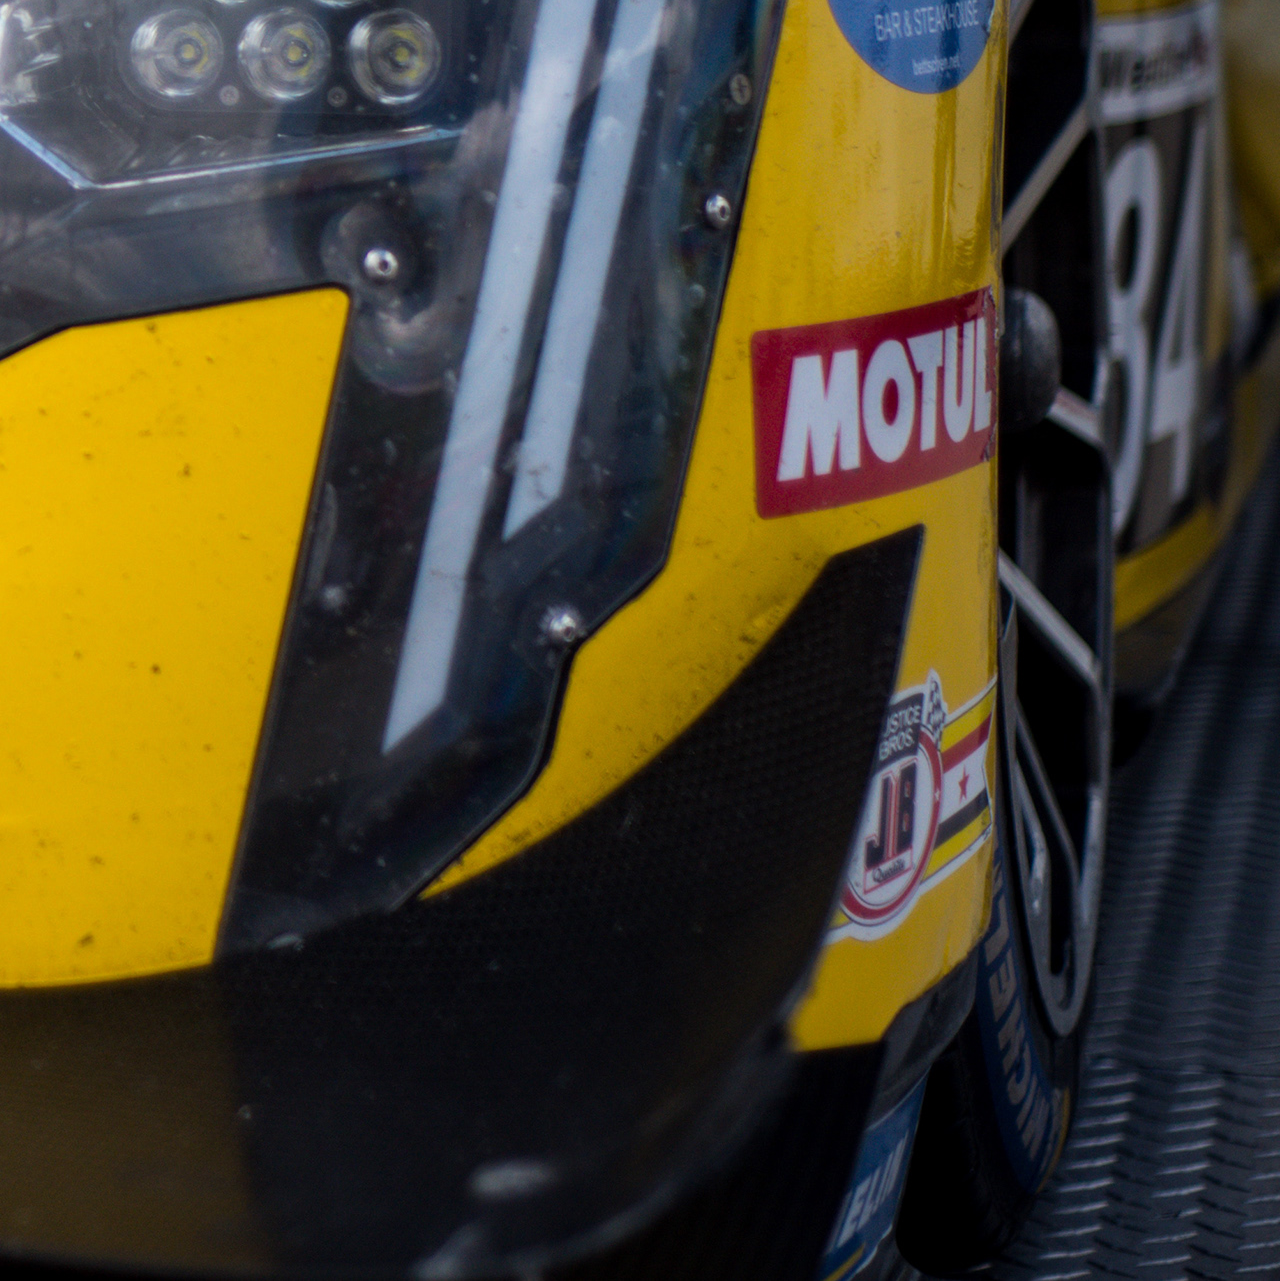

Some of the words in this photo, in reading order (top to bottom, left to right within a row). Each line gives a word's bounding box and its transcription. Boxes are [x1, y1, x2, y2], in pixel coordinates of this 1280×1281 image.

[874, 11, 903, 41] BAR
[904, 9, 913, 37] &
[913, 0, 980, 36] STEAKHOUSE
[1103, 124, 1209, 536] 84
[776, 317, 993, 482] MOTUL
[879, 728, 915, 761] BROS.
[883, 705, 922, 738] USTICE
[864, 758, 918, 869] JB
